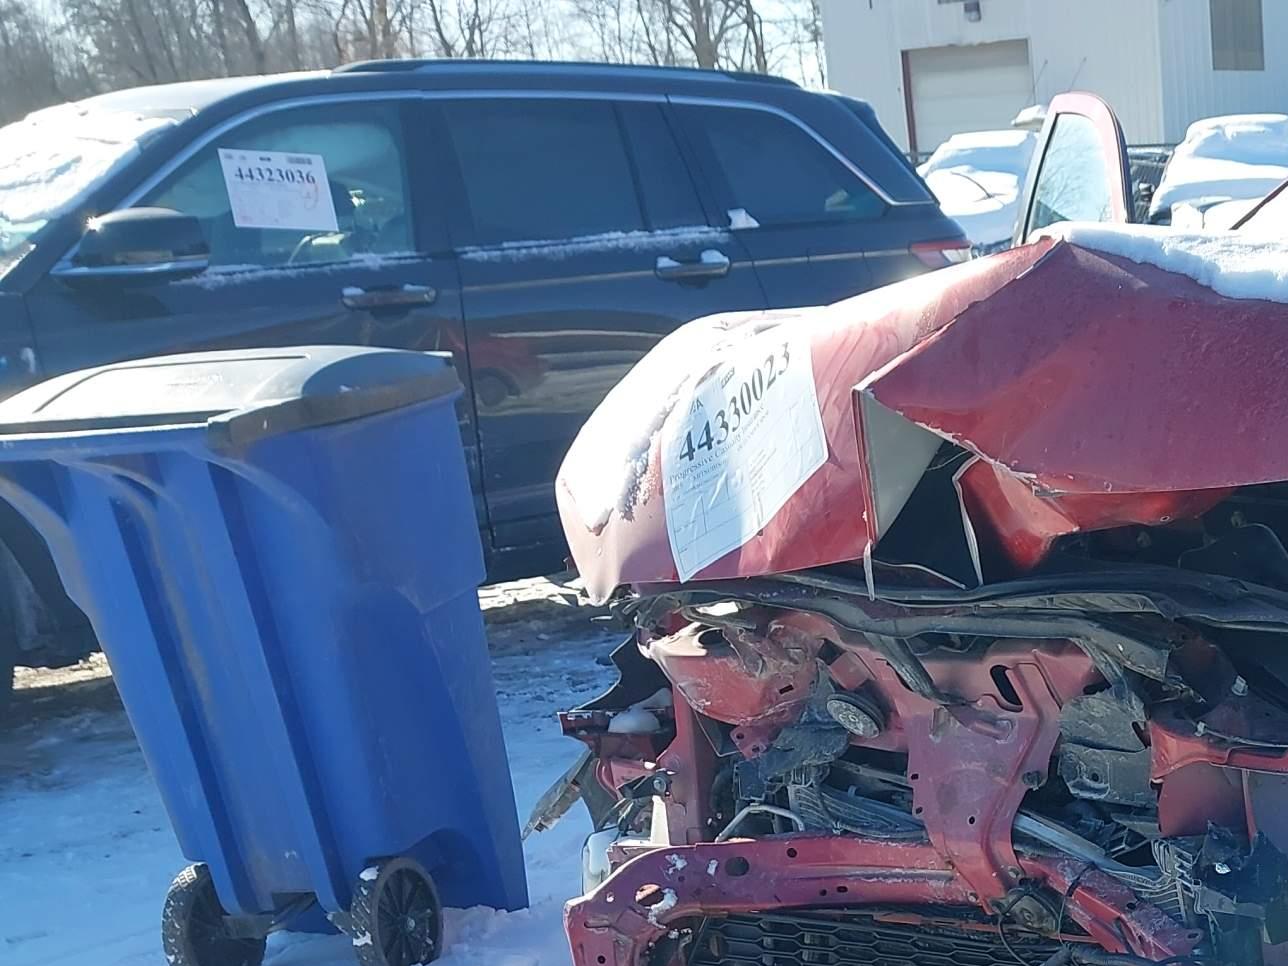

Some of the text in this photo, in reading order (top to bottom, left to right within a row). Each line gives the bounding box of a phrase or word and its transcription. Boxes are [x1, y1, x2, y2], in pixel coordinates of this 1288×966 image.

[234, 167, 316, 185] 44323036
[679, 341, 790, 462] 44330023
[669, 455, 713, 486] Progressive
